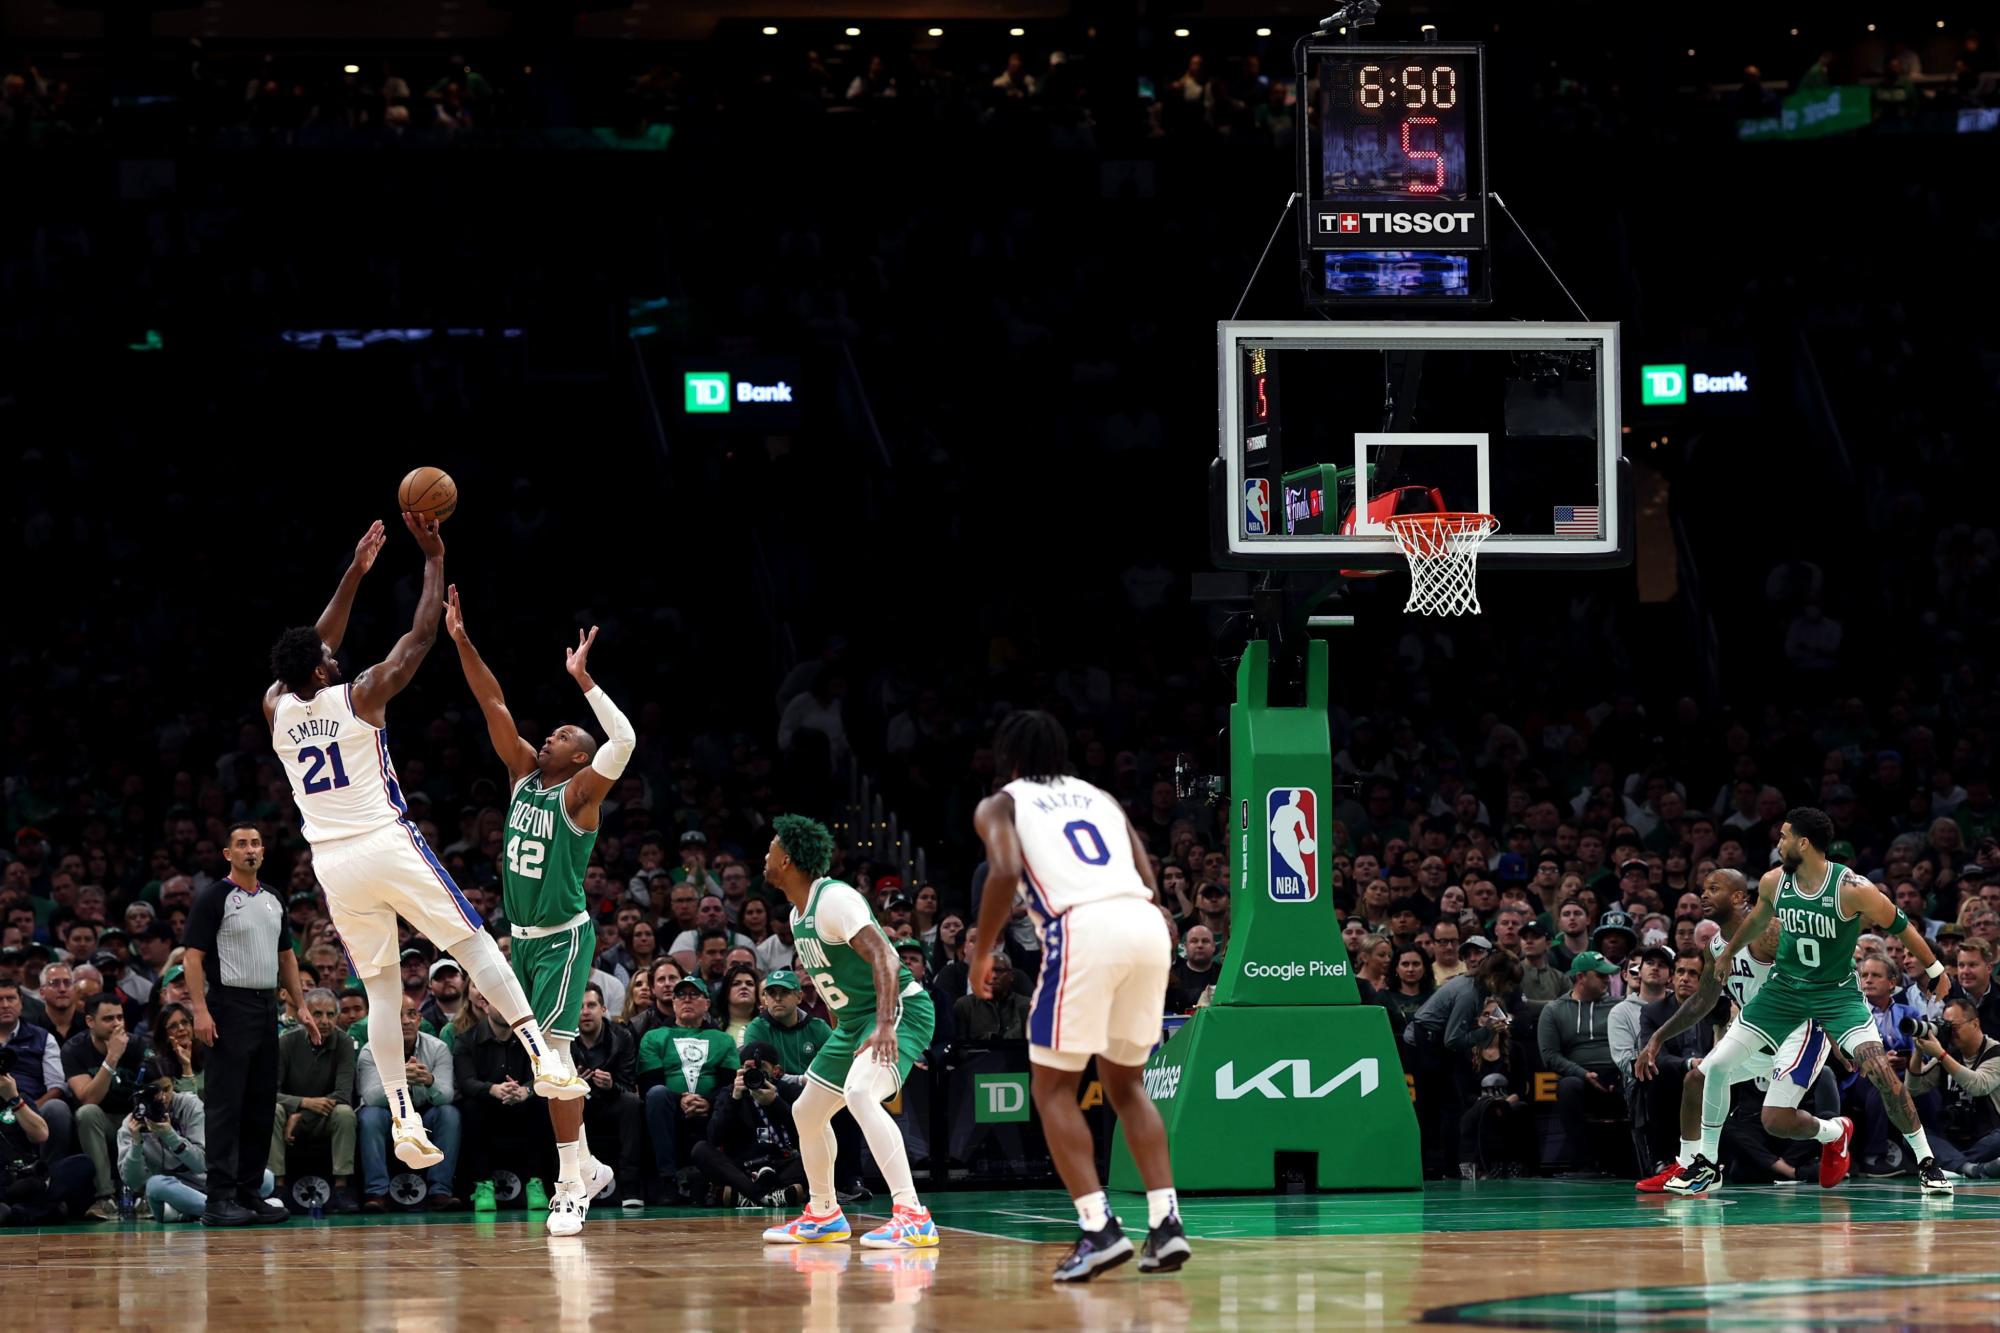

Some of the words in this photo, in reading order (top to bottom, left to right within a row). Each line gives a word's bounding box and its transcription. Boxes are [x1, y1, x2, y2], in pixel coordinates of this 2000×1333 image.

[1359, 65, 1457, 109] 6:50
[1402, 116, 1445, 193] 5
[1361, 212, 1476, 234] TISSOT
[688, 379, 726, 405] TD
[736, 381, 792, 402] Bank
[1646, 371, 1683, 398] TD
[1692, 371, 1748, 393] Bank
[1248, 521, 1261, 532] NBA
[287, 718, 340, 745] EMBIID
[297, 741, 350, 795] 21
[507, 834, 545, 880] 42
[1063, 819, 1111, 866] 0
[1276, 876, 1300, 895] NBA
[1783, 881, 1791, 890] 6
[1778, 907, 1837, 939] BOSTON
[1796, 937, 1821, 968] 0
[1244, 961, 1306, 982] Google
[1309, 960, 1347, 976] Pixel
[979, 1081, 1025, 1113] TD
